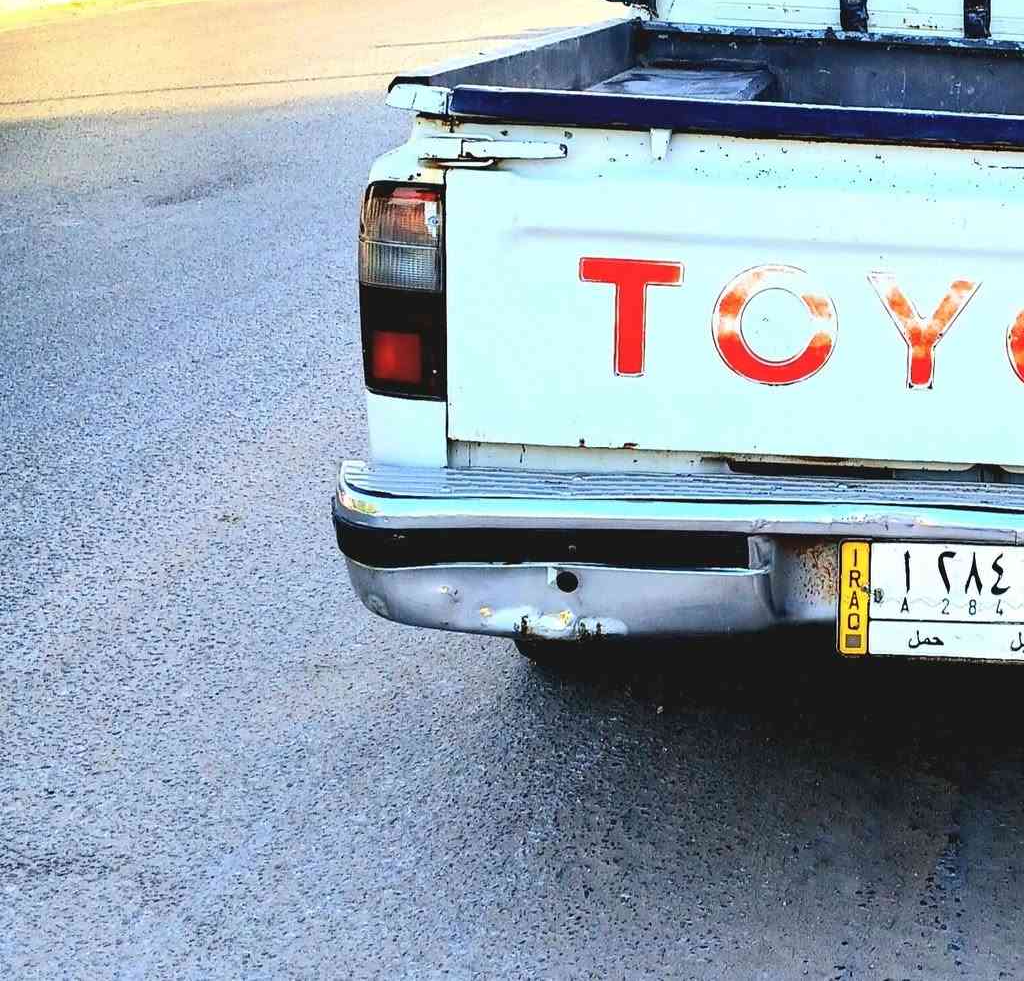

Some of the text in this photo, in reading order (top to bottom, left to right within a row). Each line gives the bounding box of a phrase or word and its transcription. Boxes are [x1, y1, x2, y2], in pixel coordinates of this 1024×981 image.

[848, 548, 862, 631] IRAQ
[900, 597, 911, 615] A
[907, 629, 945, 650] حمل
